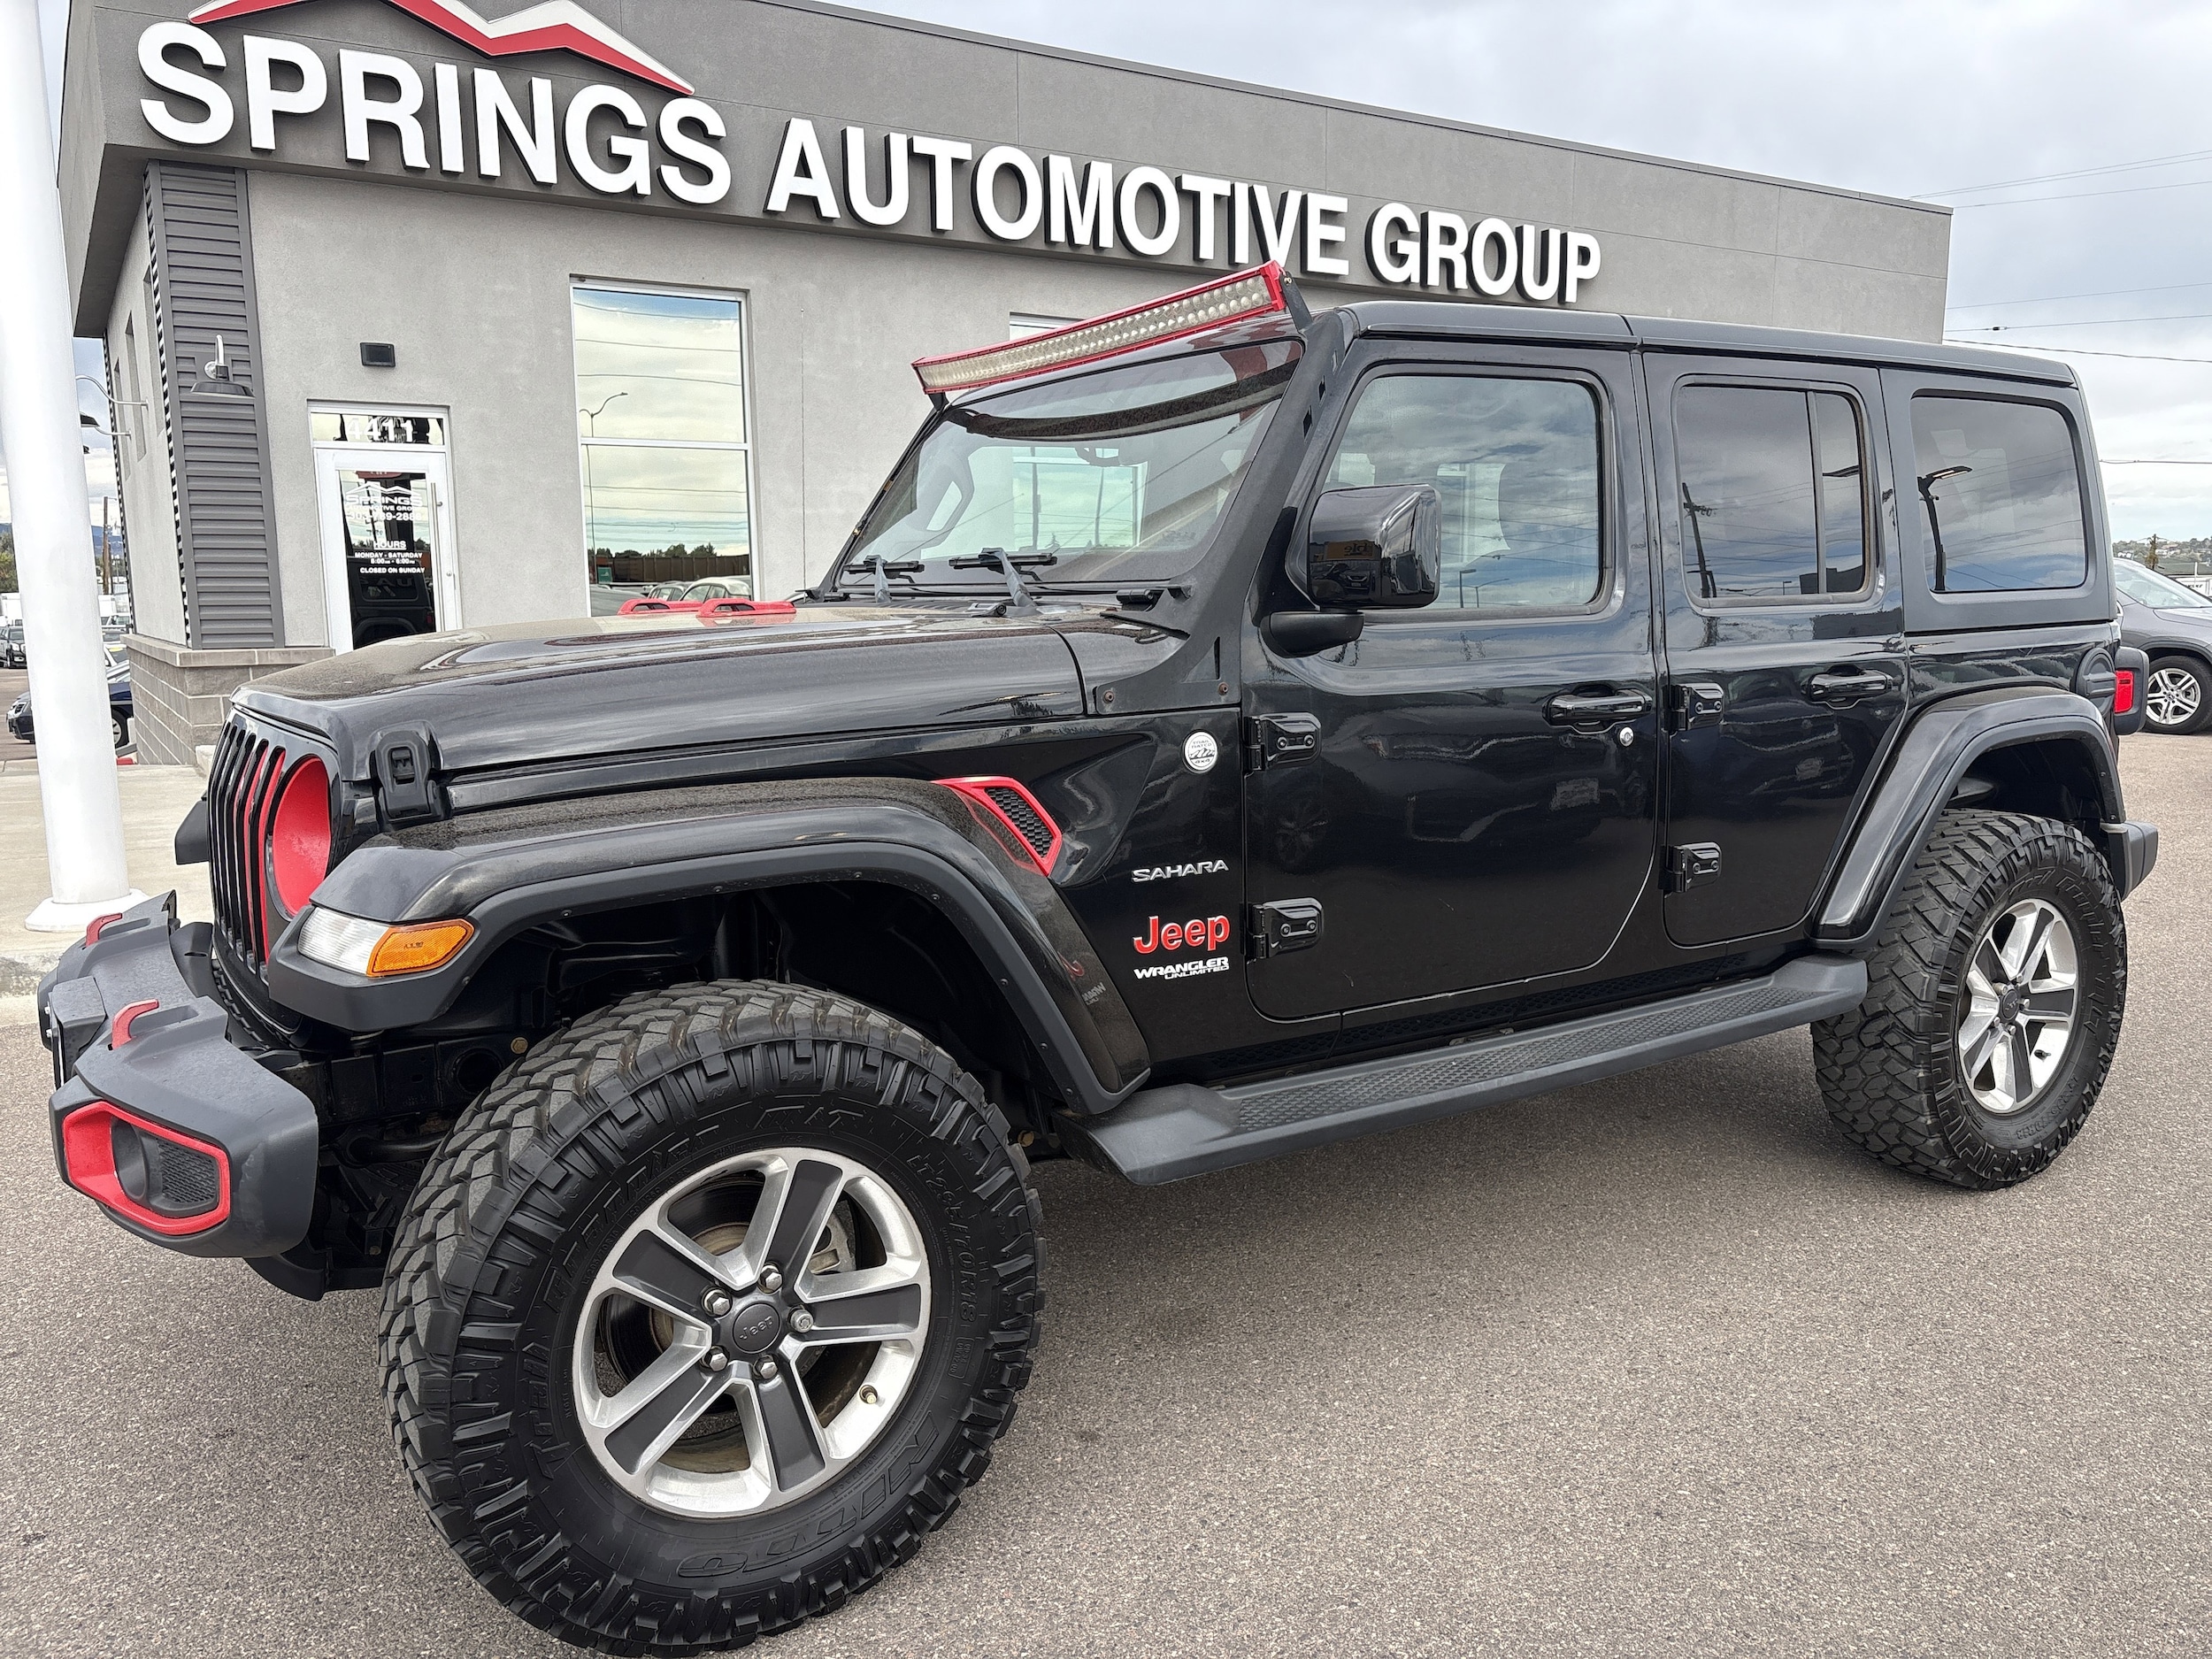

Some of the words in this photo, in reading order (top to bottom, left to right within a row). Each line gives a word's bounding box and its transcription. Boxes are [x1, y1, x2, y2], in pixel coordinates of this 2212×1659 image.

[137, 21, 732, 205] SPRINGS
[764, 117, 1350, 276] AUTOMOTIVE
[1365, 202, 1601, 304] GROUP
[346, 417, 414, 442] 4411
[346, 494, 422, 507] SPRINGS
[373, 541, 406, 549] HOURS
[1132, 859, 1229, 882] SAHARA
[1133, 914, 1230, 955] Jeep
[1133, 956, 1230, 979] WRANGLER
[1164, 964, 1230, 979] UNLIMITED
[740, 1316, 773, 1340] Jeep
